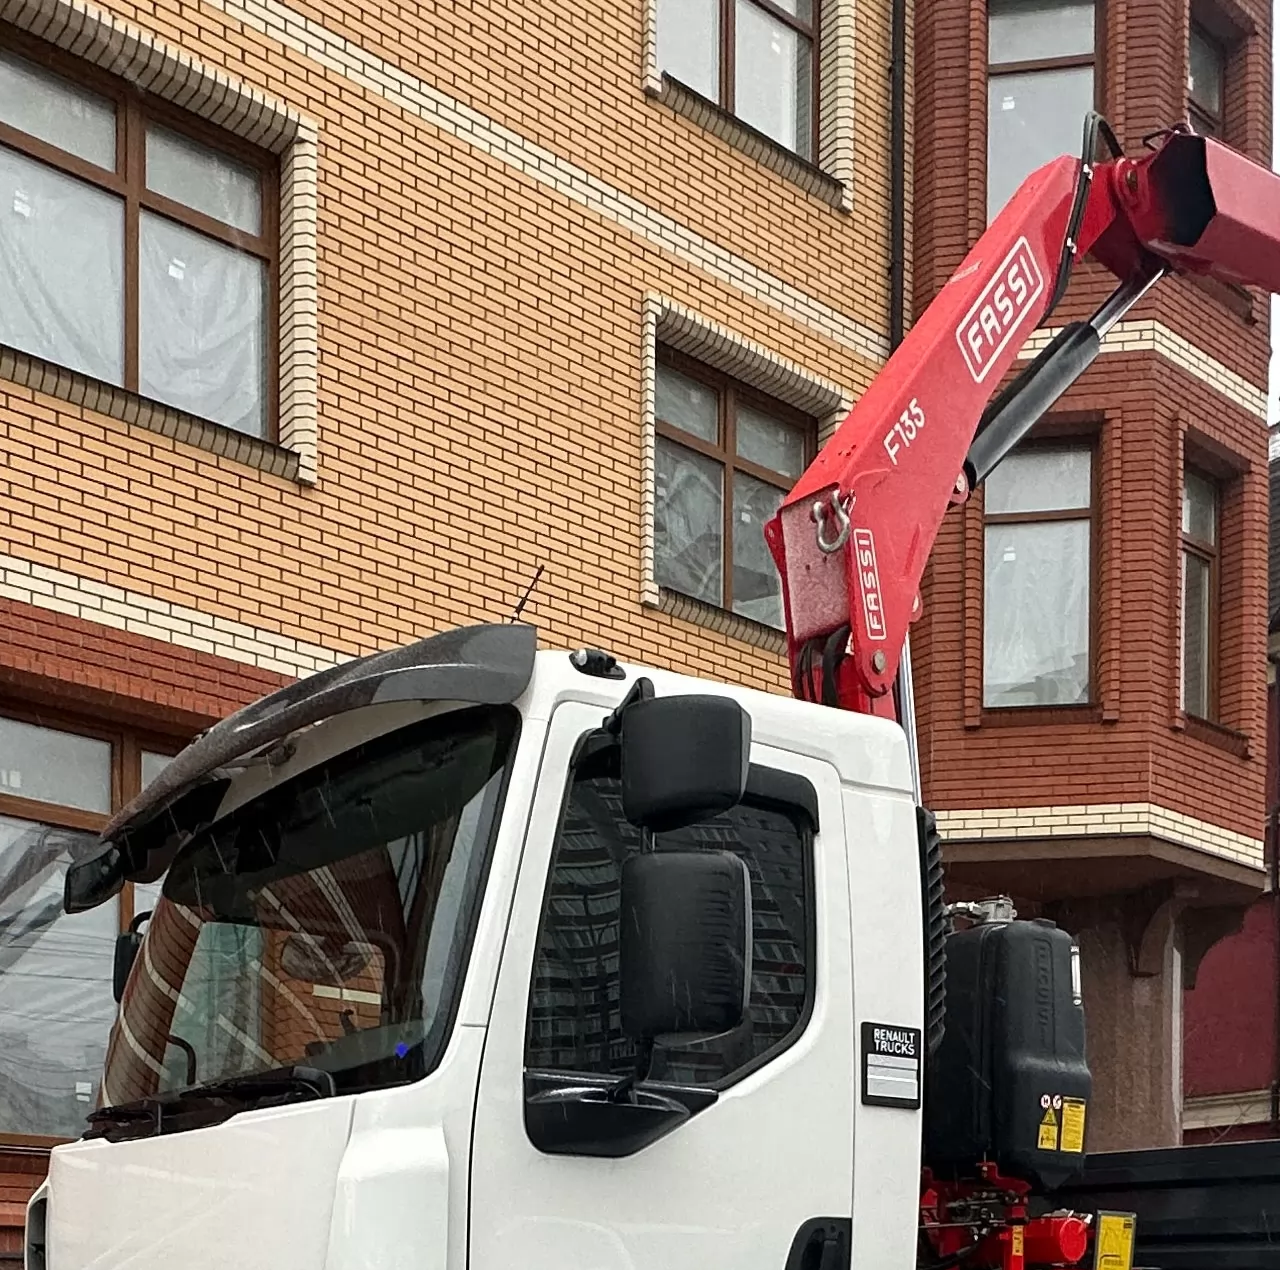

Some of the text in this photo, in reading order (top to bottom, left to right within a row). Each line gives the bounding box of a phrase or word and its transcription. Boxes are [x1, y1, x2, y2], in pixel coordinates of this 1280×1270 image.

[967, 253, 1035, 365] FASSI
[883, 396, 926, 466] F135
[858, 538, 883, 631] FASSI
[873, 1028, 916, 1044] RENAULT
[874, 1039, 916, 1056] TRUCKS
